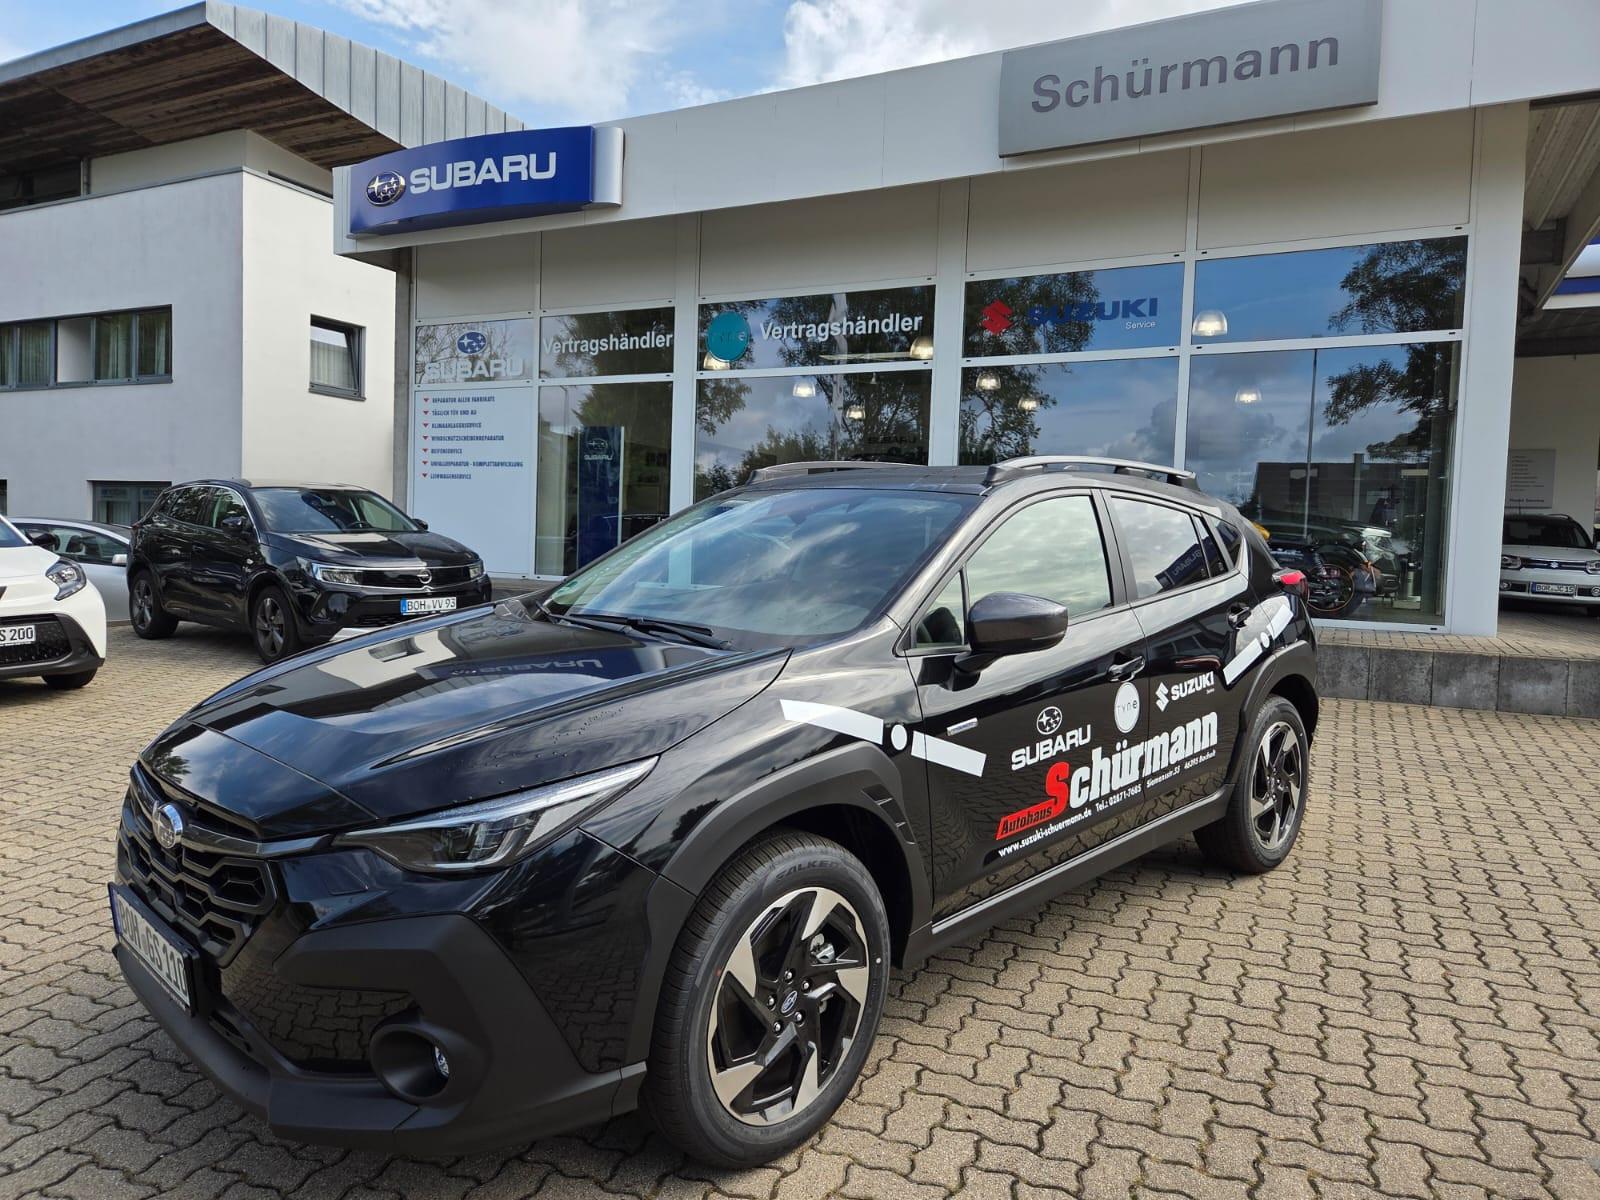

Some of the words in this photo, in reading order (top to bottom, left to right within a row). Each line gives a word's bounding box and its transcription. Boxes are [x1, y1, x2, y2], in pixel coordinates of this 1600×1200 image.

[1031, 36, 1339, 113] Schürmann
[409, 152, 556, 194] SUBARU
[1028, 297, 1158, 327] SUZUKI
[1125, 321, 1156, 330] Service
[757, 313, 923, 342] Vertragshändler
[543, 332, 673, 356] Vertragshändler
[424, 359, 524, 380] SUBARU
[407, 601, 426, 611] BOH
[431, 599, 443, 609] VV
[445, 598, 455, 608] 93
[10, 627, 34, 641] 200
[1171, 671, 1215, 701] SUZUKI
[1011, 724, 1091, 771] SUBARU
[1045, 711, 1218, 815] Schürmann
[998, 808, 1092, 857] www.suzuki-schuermann.de
[1003, 806, 1053, 835] Autohaus
